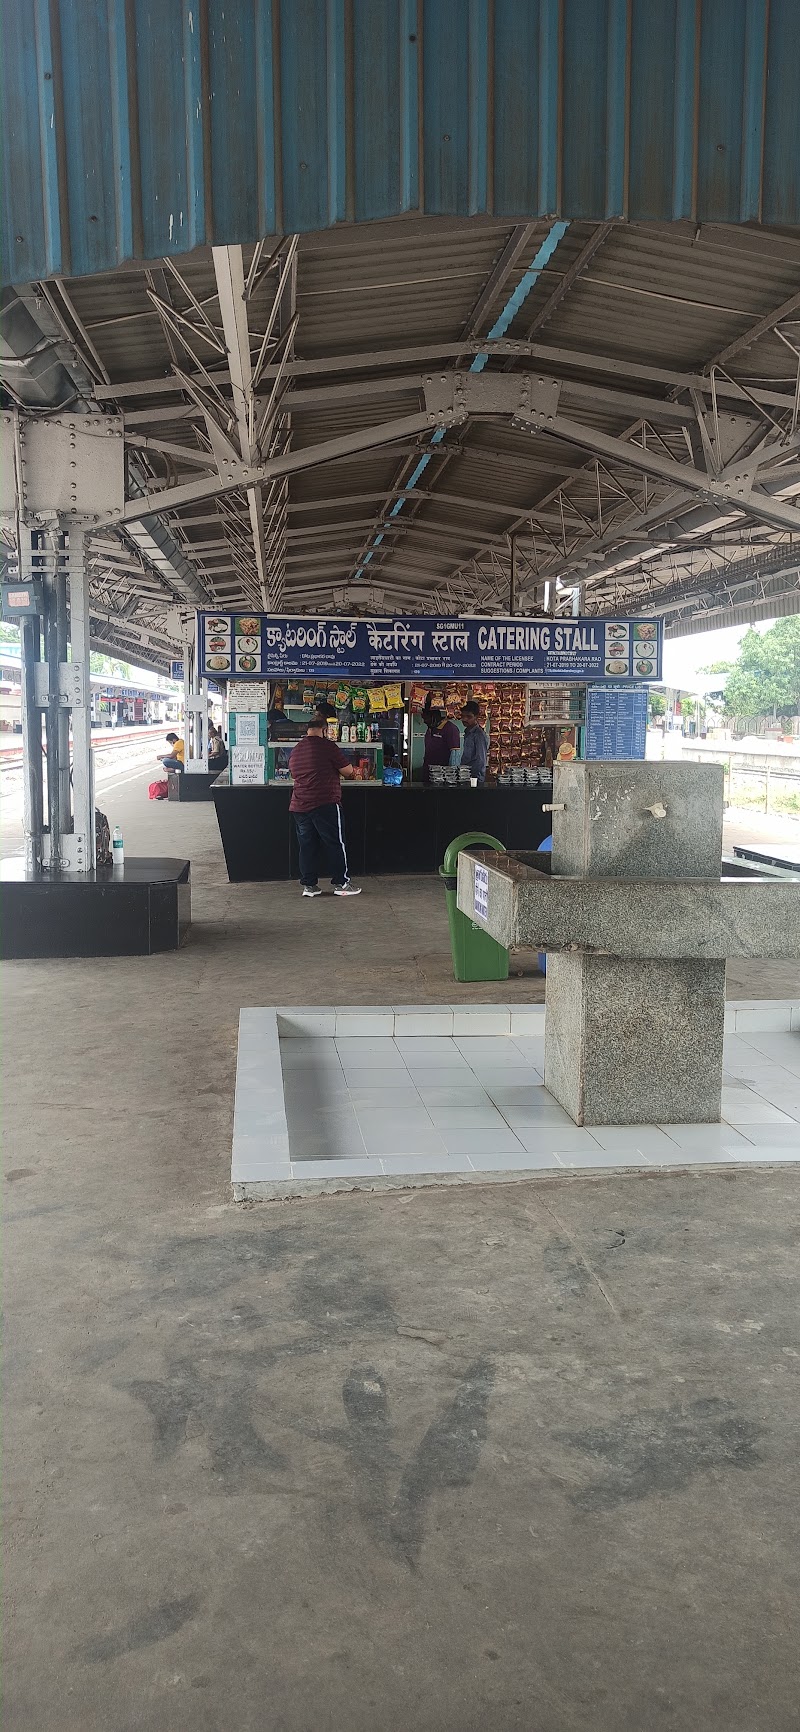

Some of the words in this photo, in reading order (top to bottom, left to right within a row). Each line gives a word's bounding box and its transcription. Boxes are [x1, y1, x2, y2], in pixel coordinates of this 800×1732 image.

[266, 621, 327, 653] క్యాటరింగ్
[329, 622, 358, 654] స్టాల్
[366, 621, 425, 652] कैटरिंग
[431, 631, 470, 653] स्टाल
[477, 626, 551, 651] CATERING
[554, 627, 599, 651] STALL
